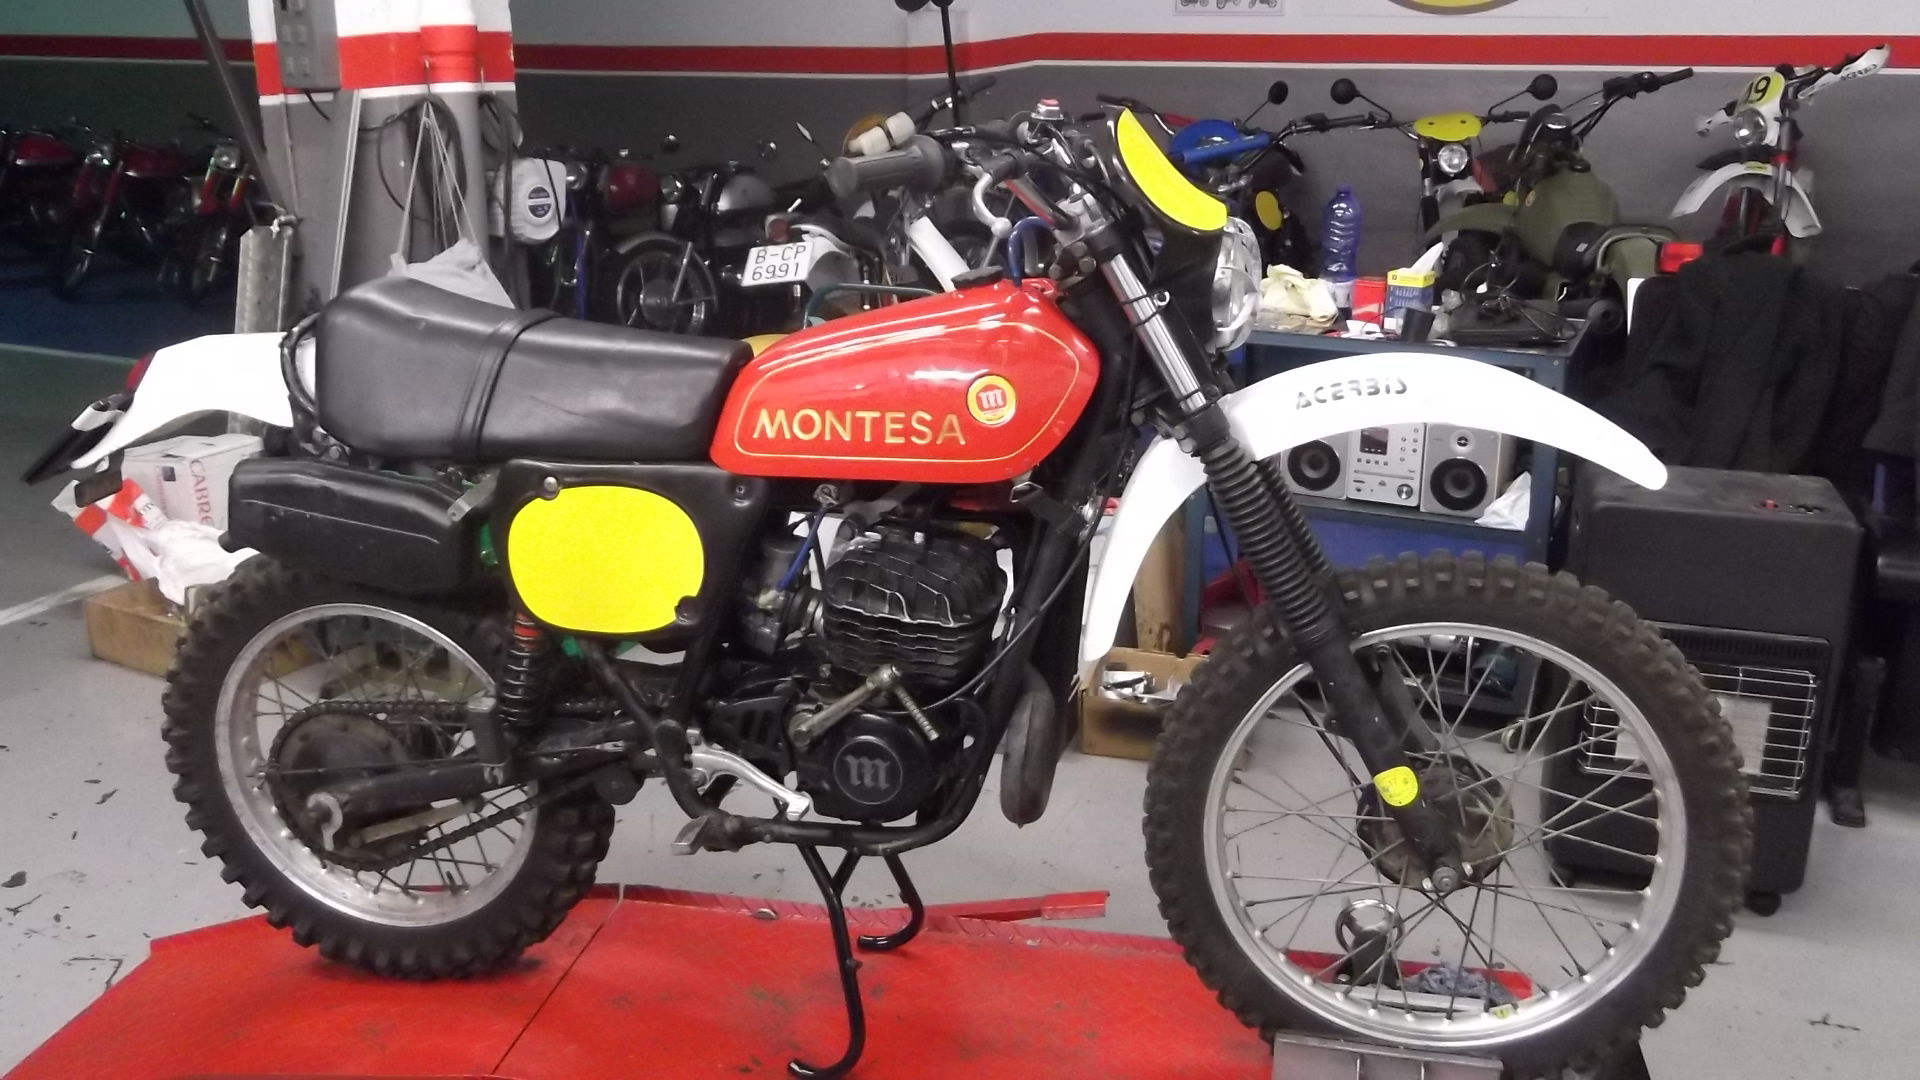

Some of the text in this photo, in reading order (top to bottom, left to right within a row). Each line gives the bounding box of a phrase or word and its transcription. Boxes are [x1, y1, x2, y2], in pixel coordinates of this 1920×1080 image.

[755, 244, 806, 265] B-CP
[751, 262, 799, 281] 6991
[751, 408, 966, 446] MONTESA
